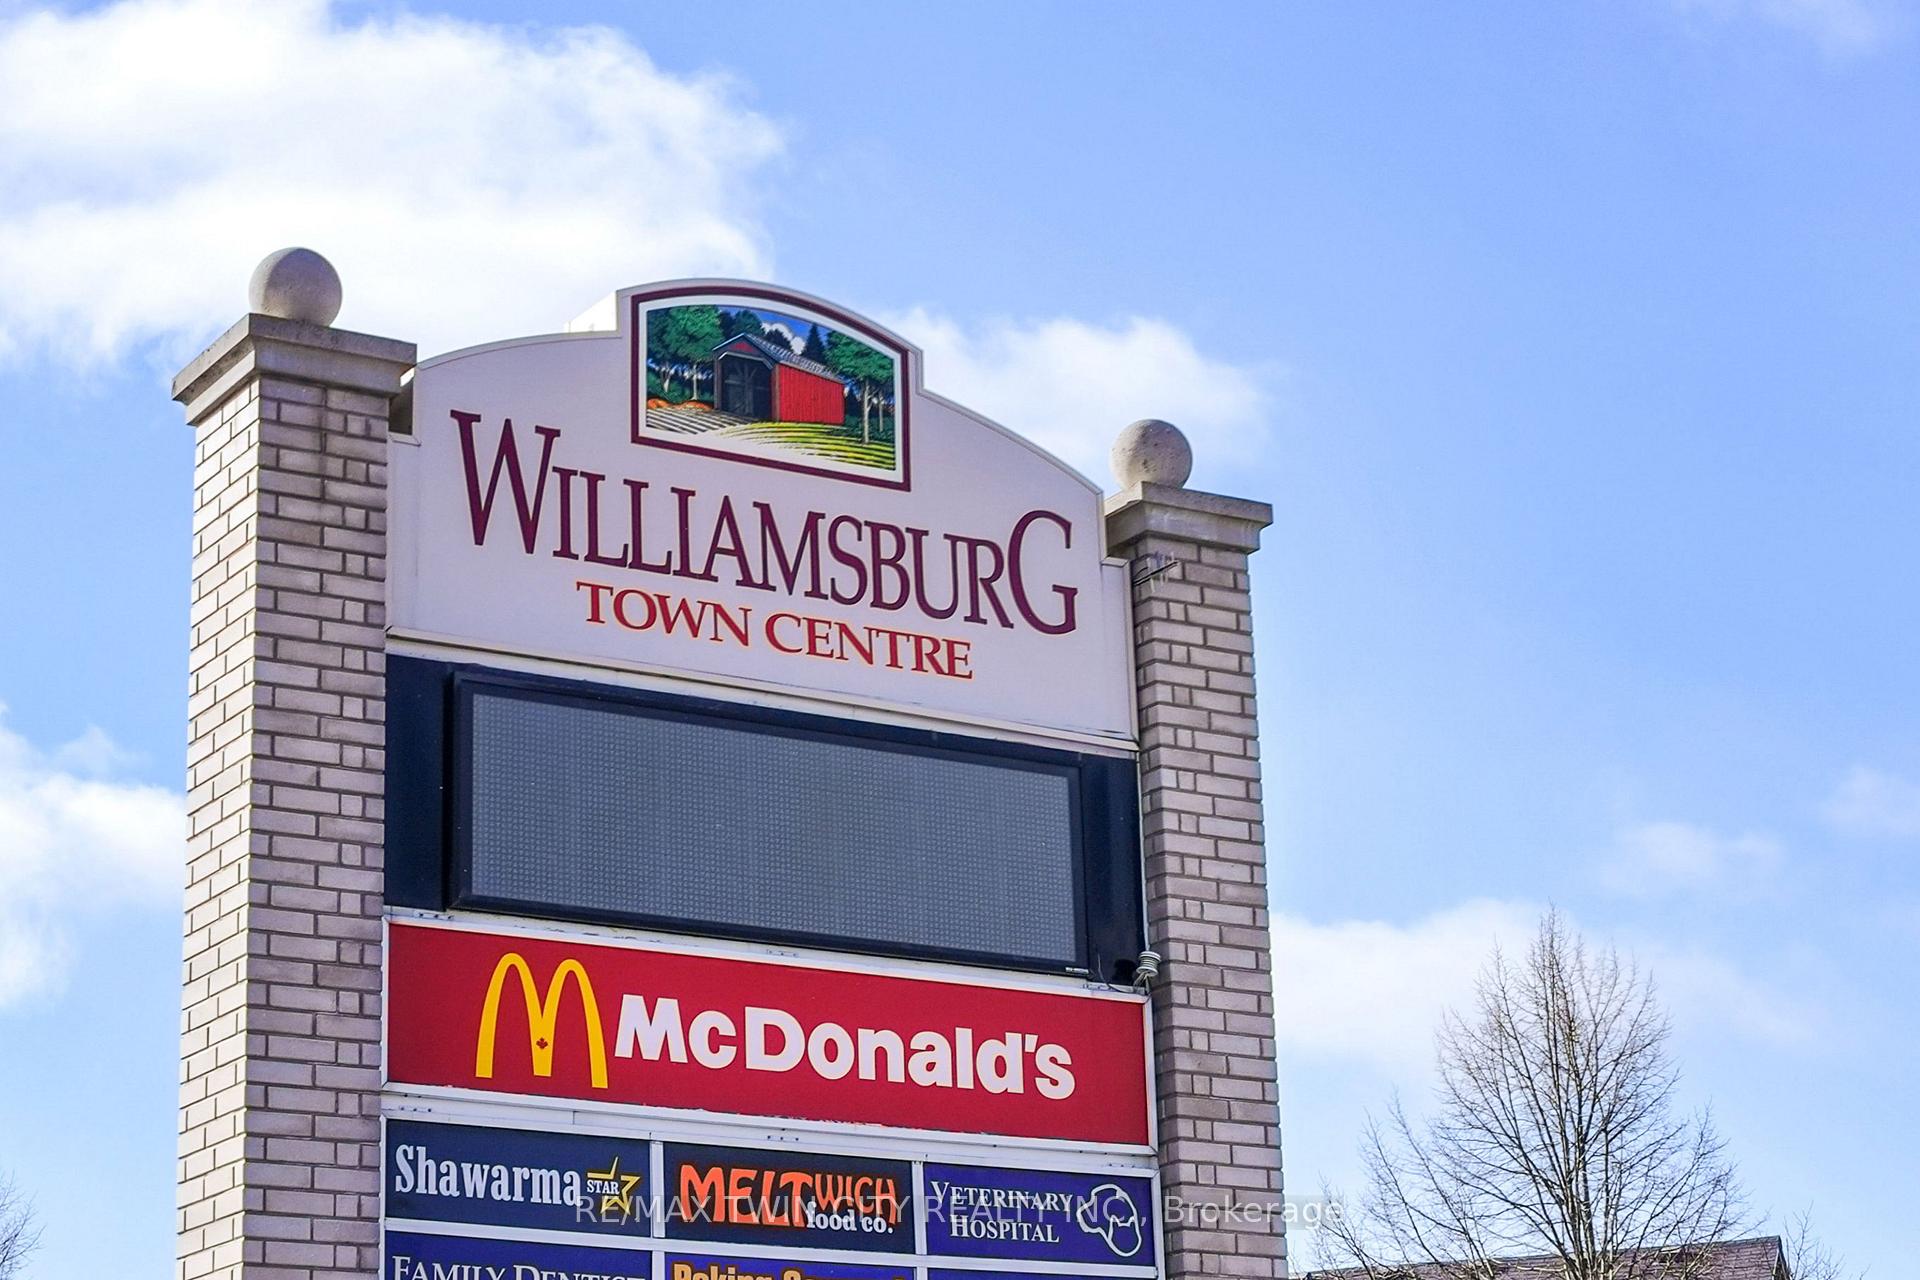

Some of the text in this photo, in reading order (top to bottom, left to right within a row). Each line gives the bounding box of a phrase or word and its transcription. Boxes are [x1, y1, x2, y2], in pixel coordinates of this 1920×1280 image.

[450, 409, 1079, 636] WILLIAMSBURG
[576, 581, 974, 680] TOWN CENTRE
[614, 993, 1076, 1100] McDonald's
[394, 1143, 584, 1207] Shawarma
[585, 1178, 620, 1195] STAR
[930, 1181, 1074, 1212] VETERINARY
[805, 1202, 893, 1234] food co.
[950, 1214, 1060, 1243] HOSPITAL
